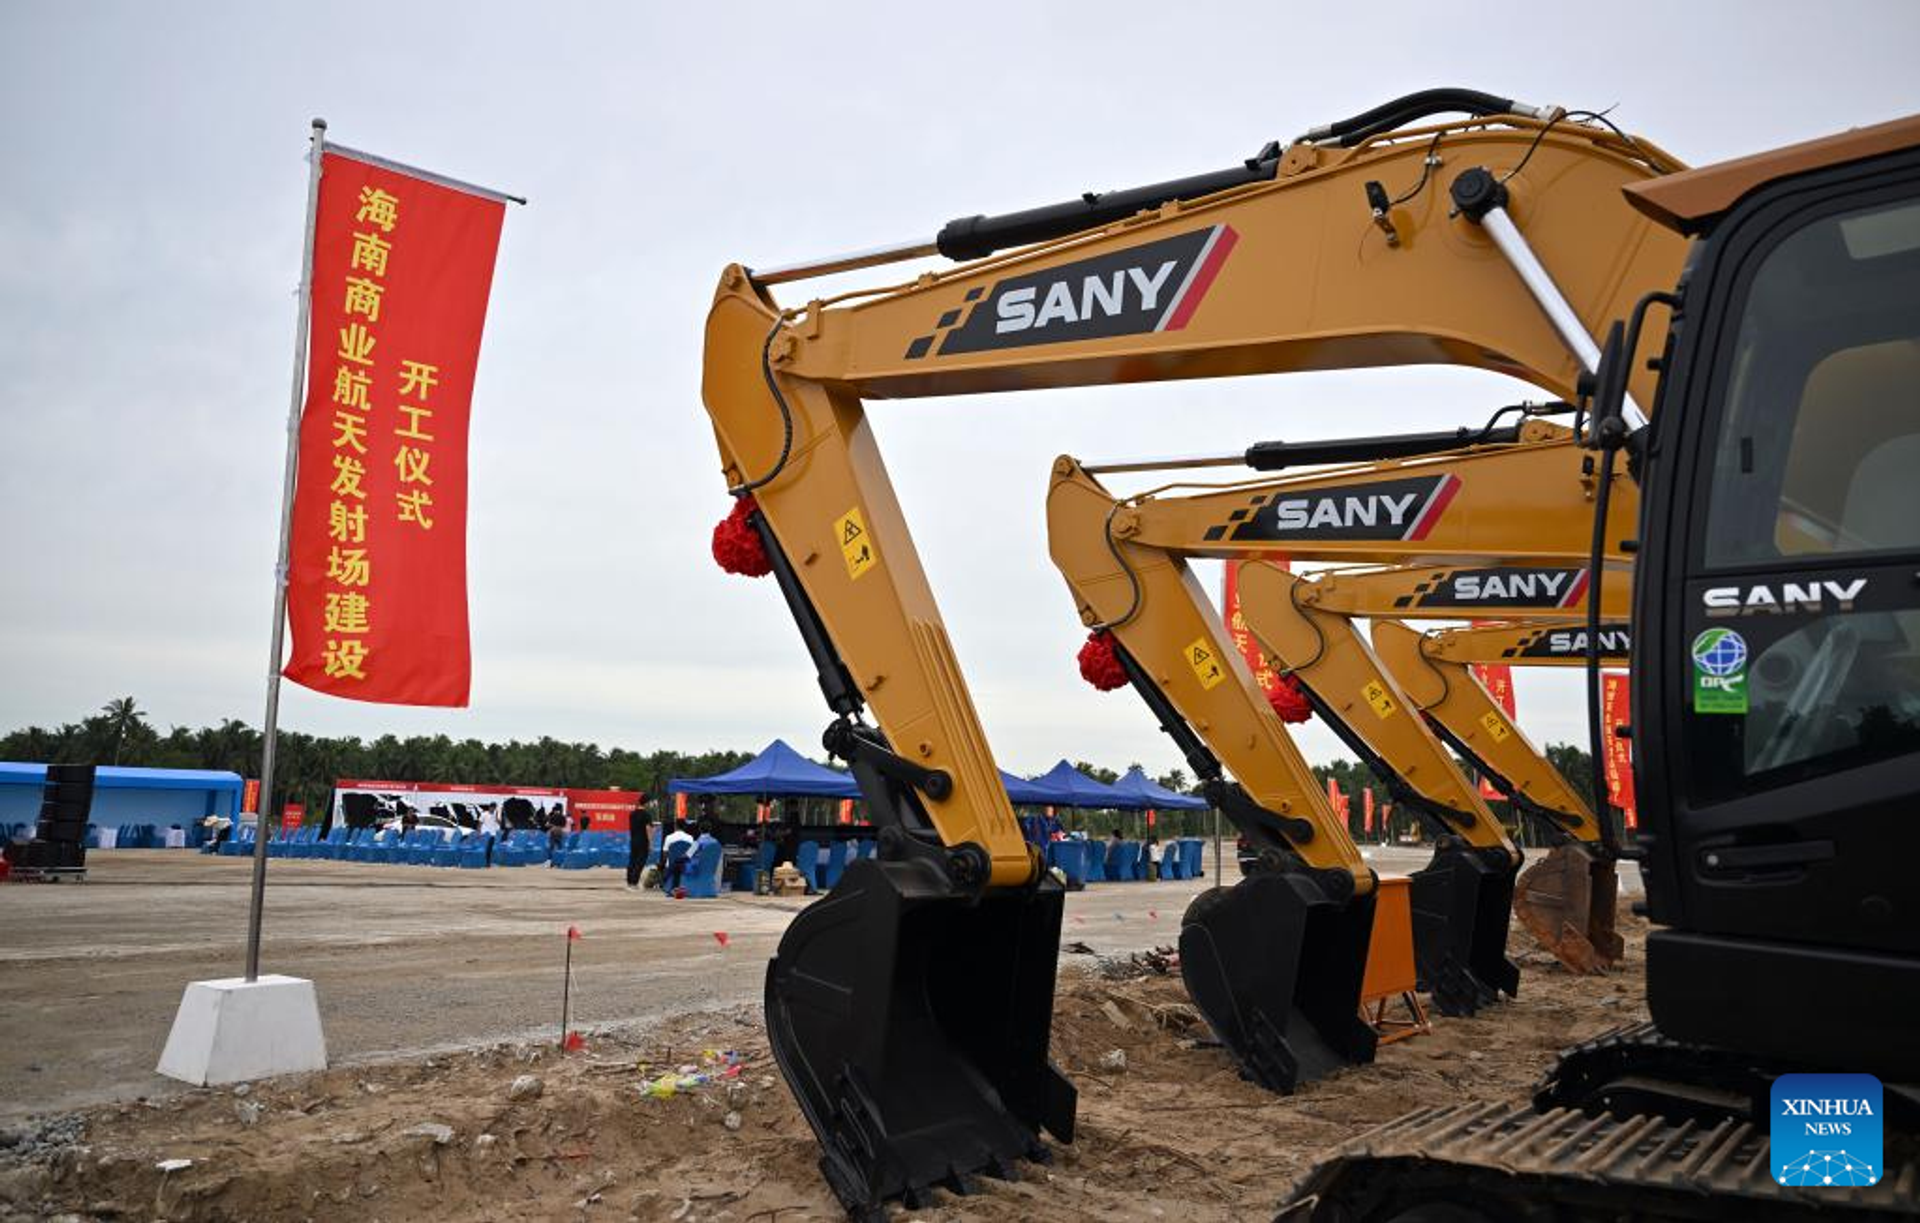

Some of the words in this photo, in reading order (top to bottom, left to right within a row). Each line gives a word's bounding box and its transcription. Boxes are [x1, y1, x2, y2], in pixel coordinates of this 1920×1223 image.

[995, 260, 1178, 334] SANY
[320, 184, 399, 681] 海南商业航天发射场建设
[394, 358, 439, 531] 开工仪式
[1277, 493, 1418, 531] SANY
[1454, 572, 1567, 600] SANY
[1703, 579, 1868, 617] SANY
